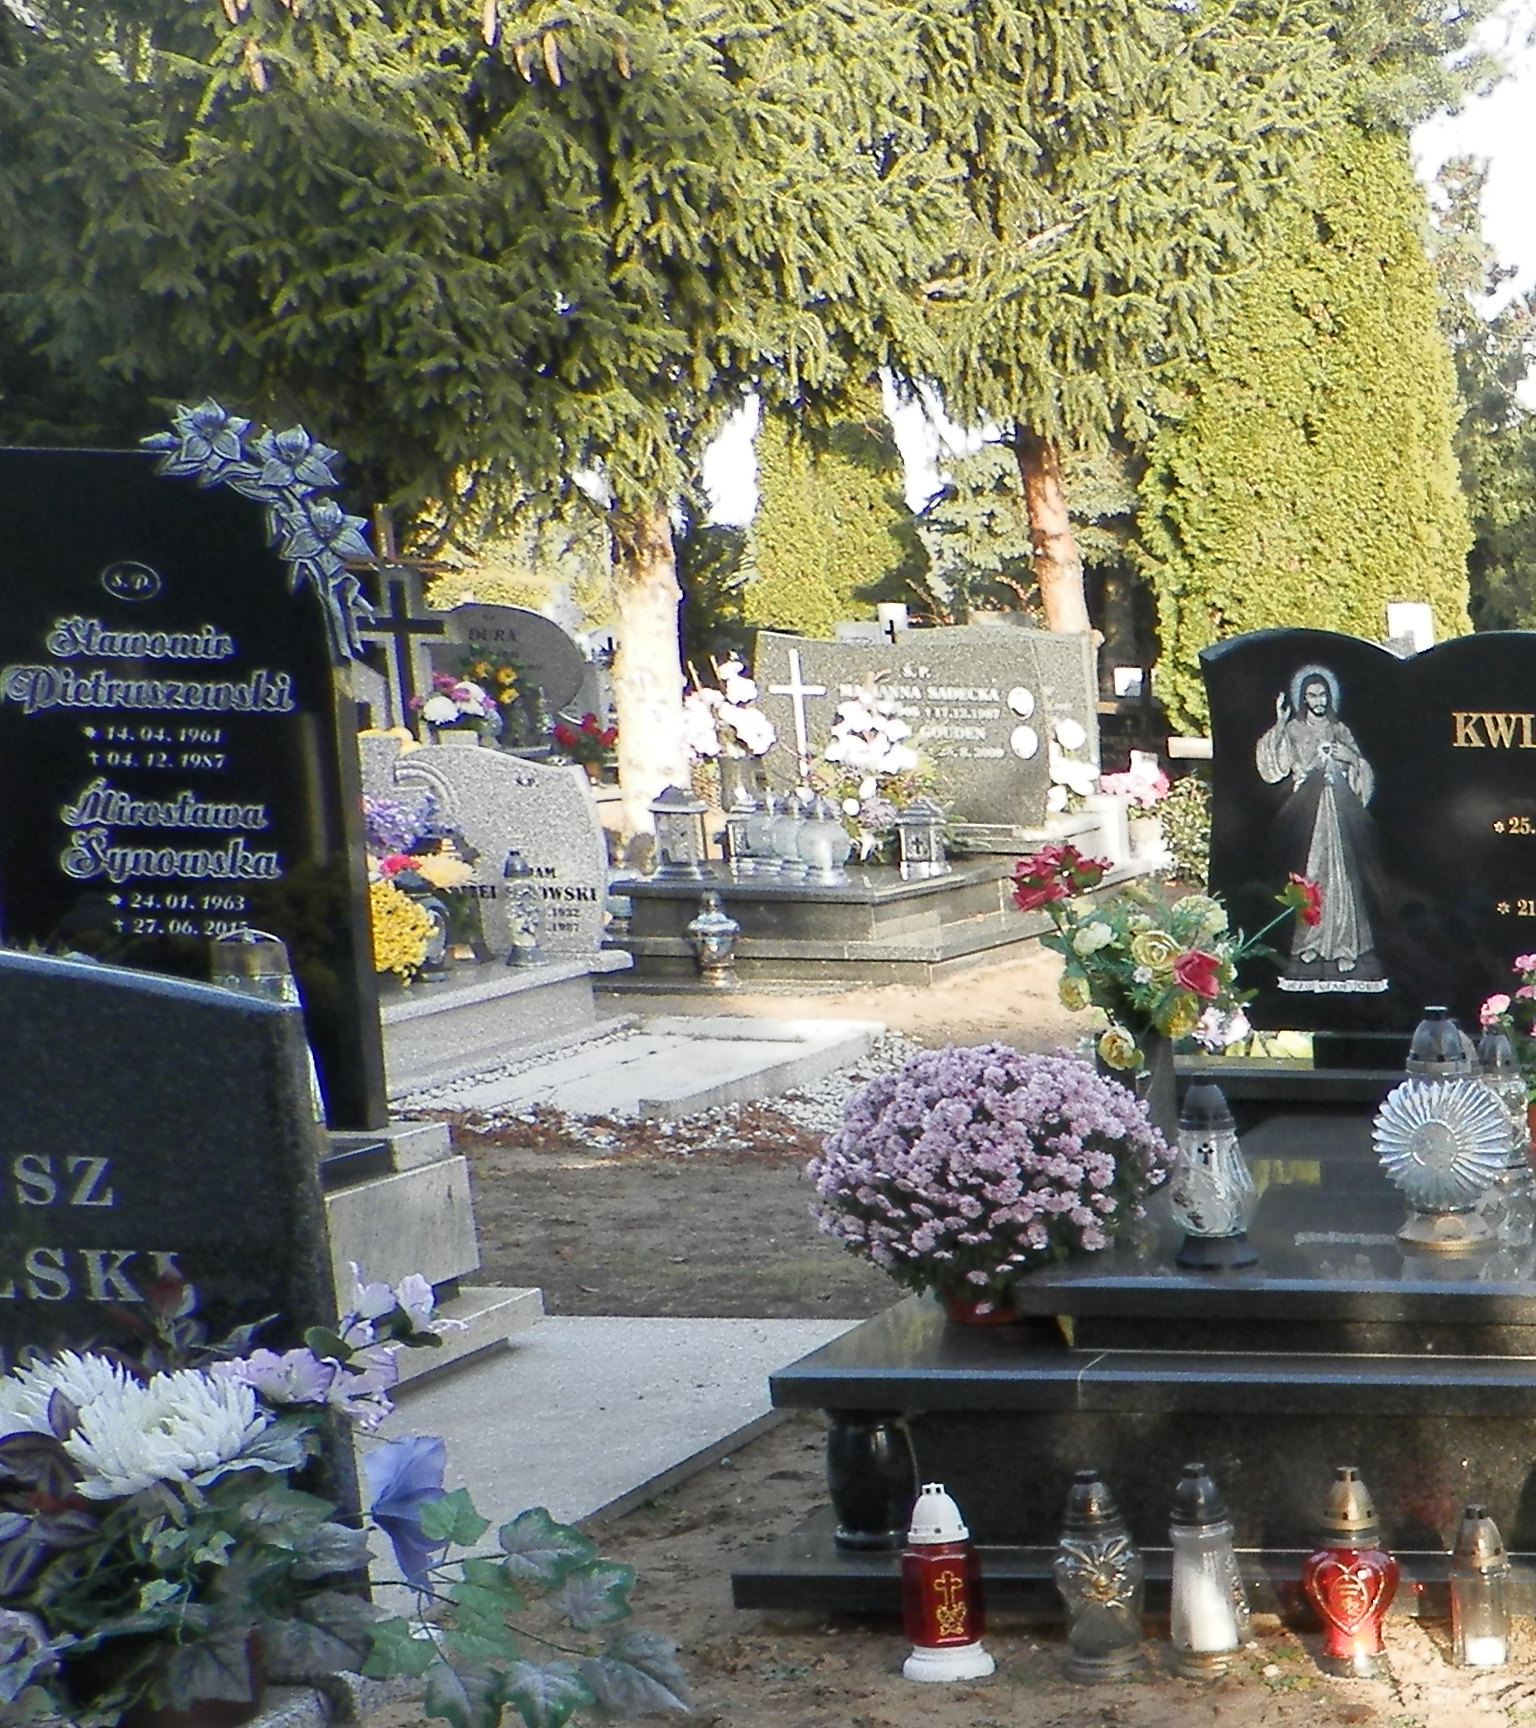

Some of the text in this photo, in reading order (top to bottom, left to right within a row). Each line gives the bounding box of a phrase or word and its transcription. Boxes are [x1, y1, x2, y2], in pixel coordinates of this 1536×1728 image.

[0, 664, 296, 714] Pietruszewski
[106, 726, 222, 743] 14. 04. 1961
[106, 752, 226, 769] 04. 12. 1987
[1508, 817, 1536, 836] 25.
[60, 827, 283, 883] Synowska
[130, 894, 246, 911] 24. 01. 1963
[133, 919, 164, 934] 27.
[169, 919, 198, 935] 06.
[0, 1247, 180, 1302] SK
